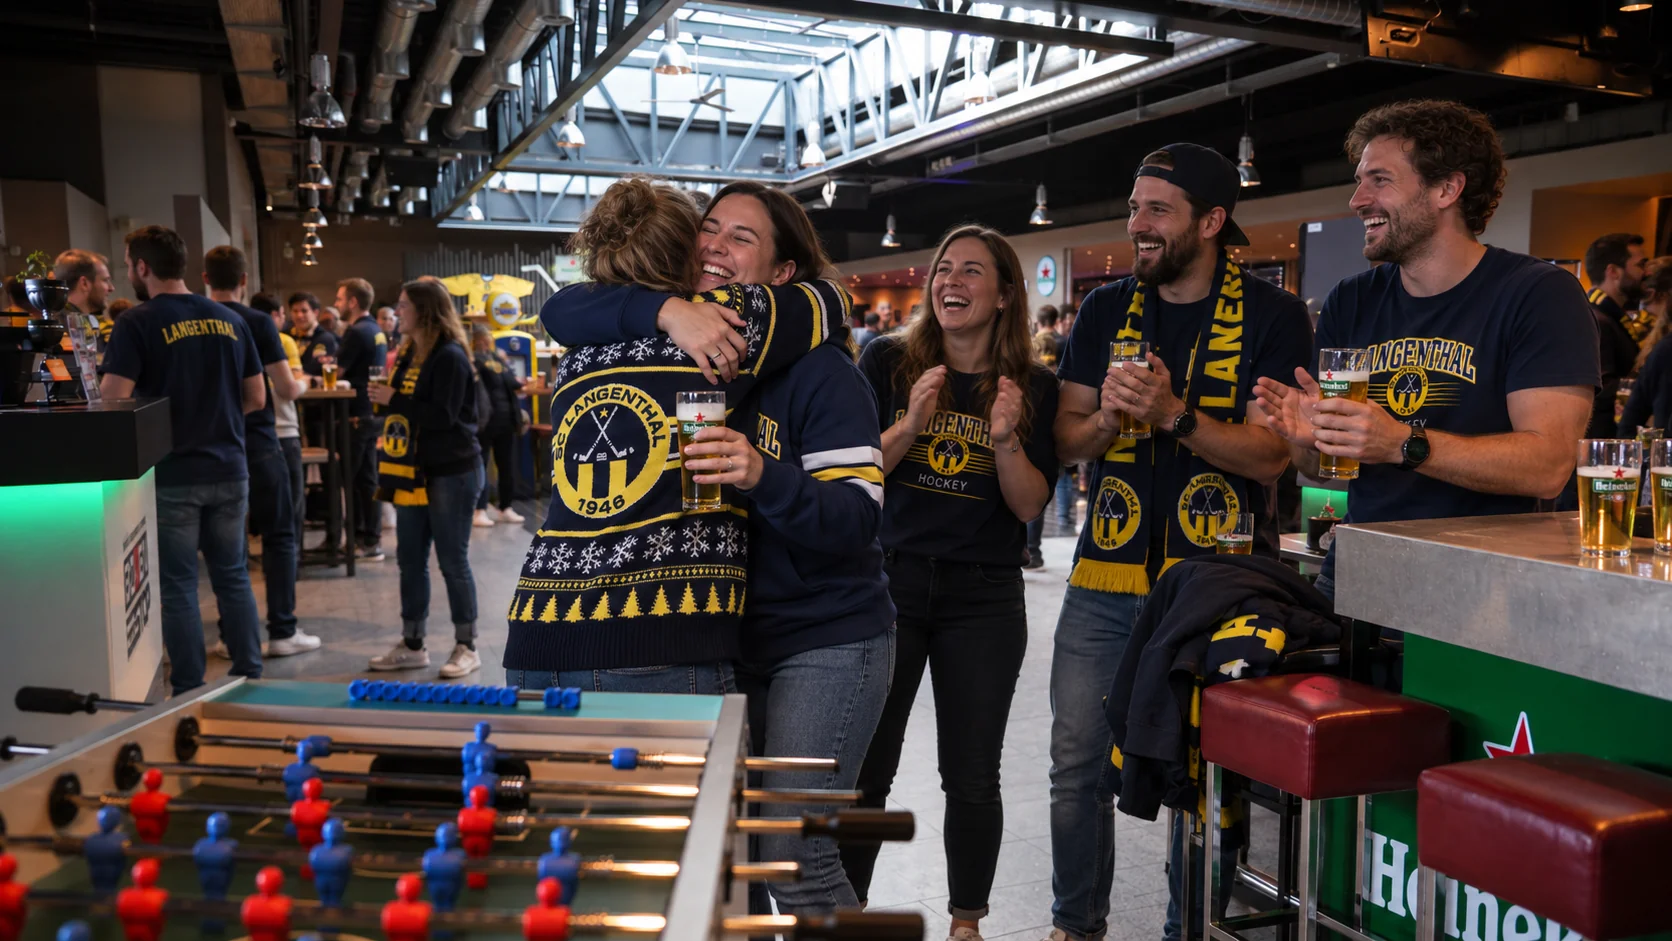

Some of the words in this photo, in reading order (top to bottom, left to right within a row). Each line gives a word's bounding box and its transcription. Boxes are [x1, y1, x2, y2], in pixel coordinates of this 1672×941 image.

[162, 319, 238, 344] LANGENTHAL
[1354, 337, 1477, 385] ANGENTHAL
[565, 387, 666, 448] LANGENTHAL
[918, 473, 968, 491] HOCKEY
[578, 494, 626, 515] 1946
[1365, 832, 1583, 941] Hine
